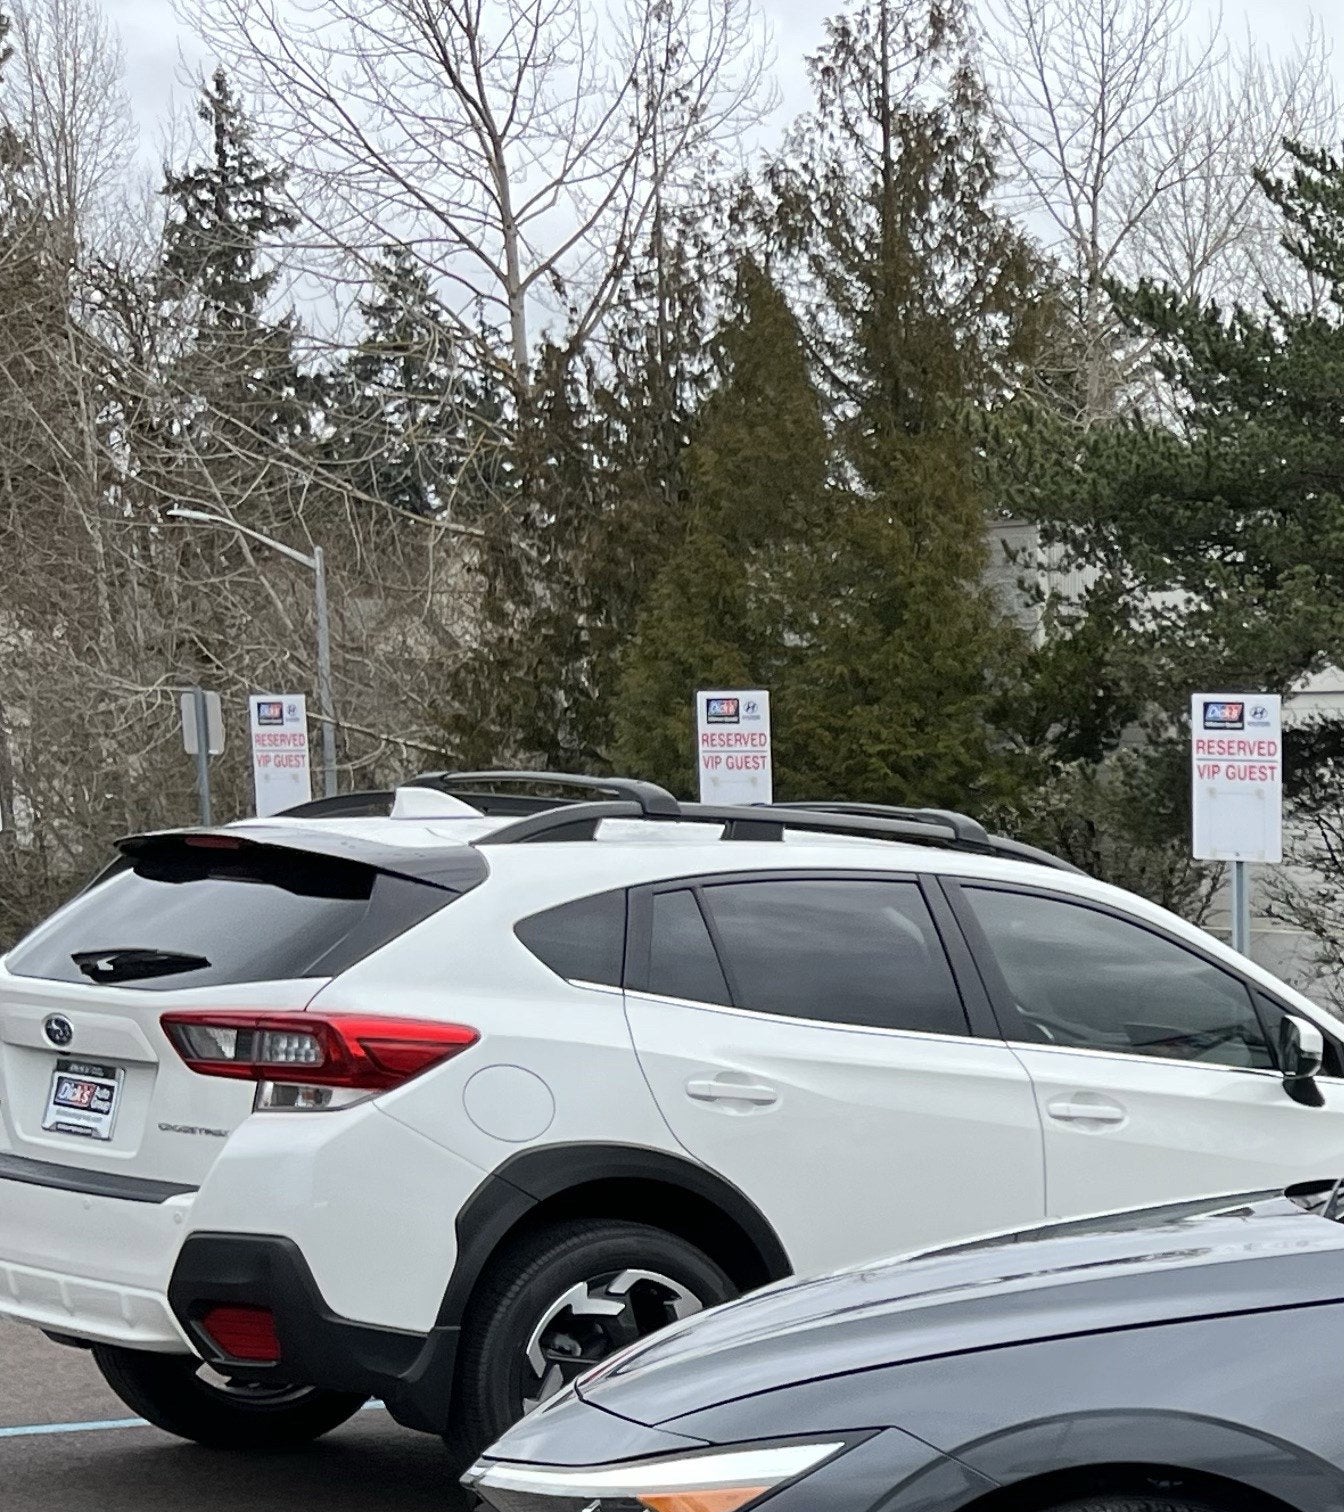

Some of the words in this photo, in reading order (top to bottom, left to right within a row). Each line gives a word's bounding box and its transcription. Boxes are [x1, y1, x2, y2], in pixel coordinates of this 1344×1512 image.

[255, 733, 306, 747] RESERVED
[702, 733, 767, 748] RESERVED
[1196, 739, 1278, 757] RESERVED
[257, 755, 271, 767] VIP
[274, 754, 306, 768] GUEST
[703, 755, 722, 769] VIP
[726, 755, 768, 770] GUEST
[1197, 764, 1221, 780] VIP
[1225, 764, 1278, 781] GUEST
